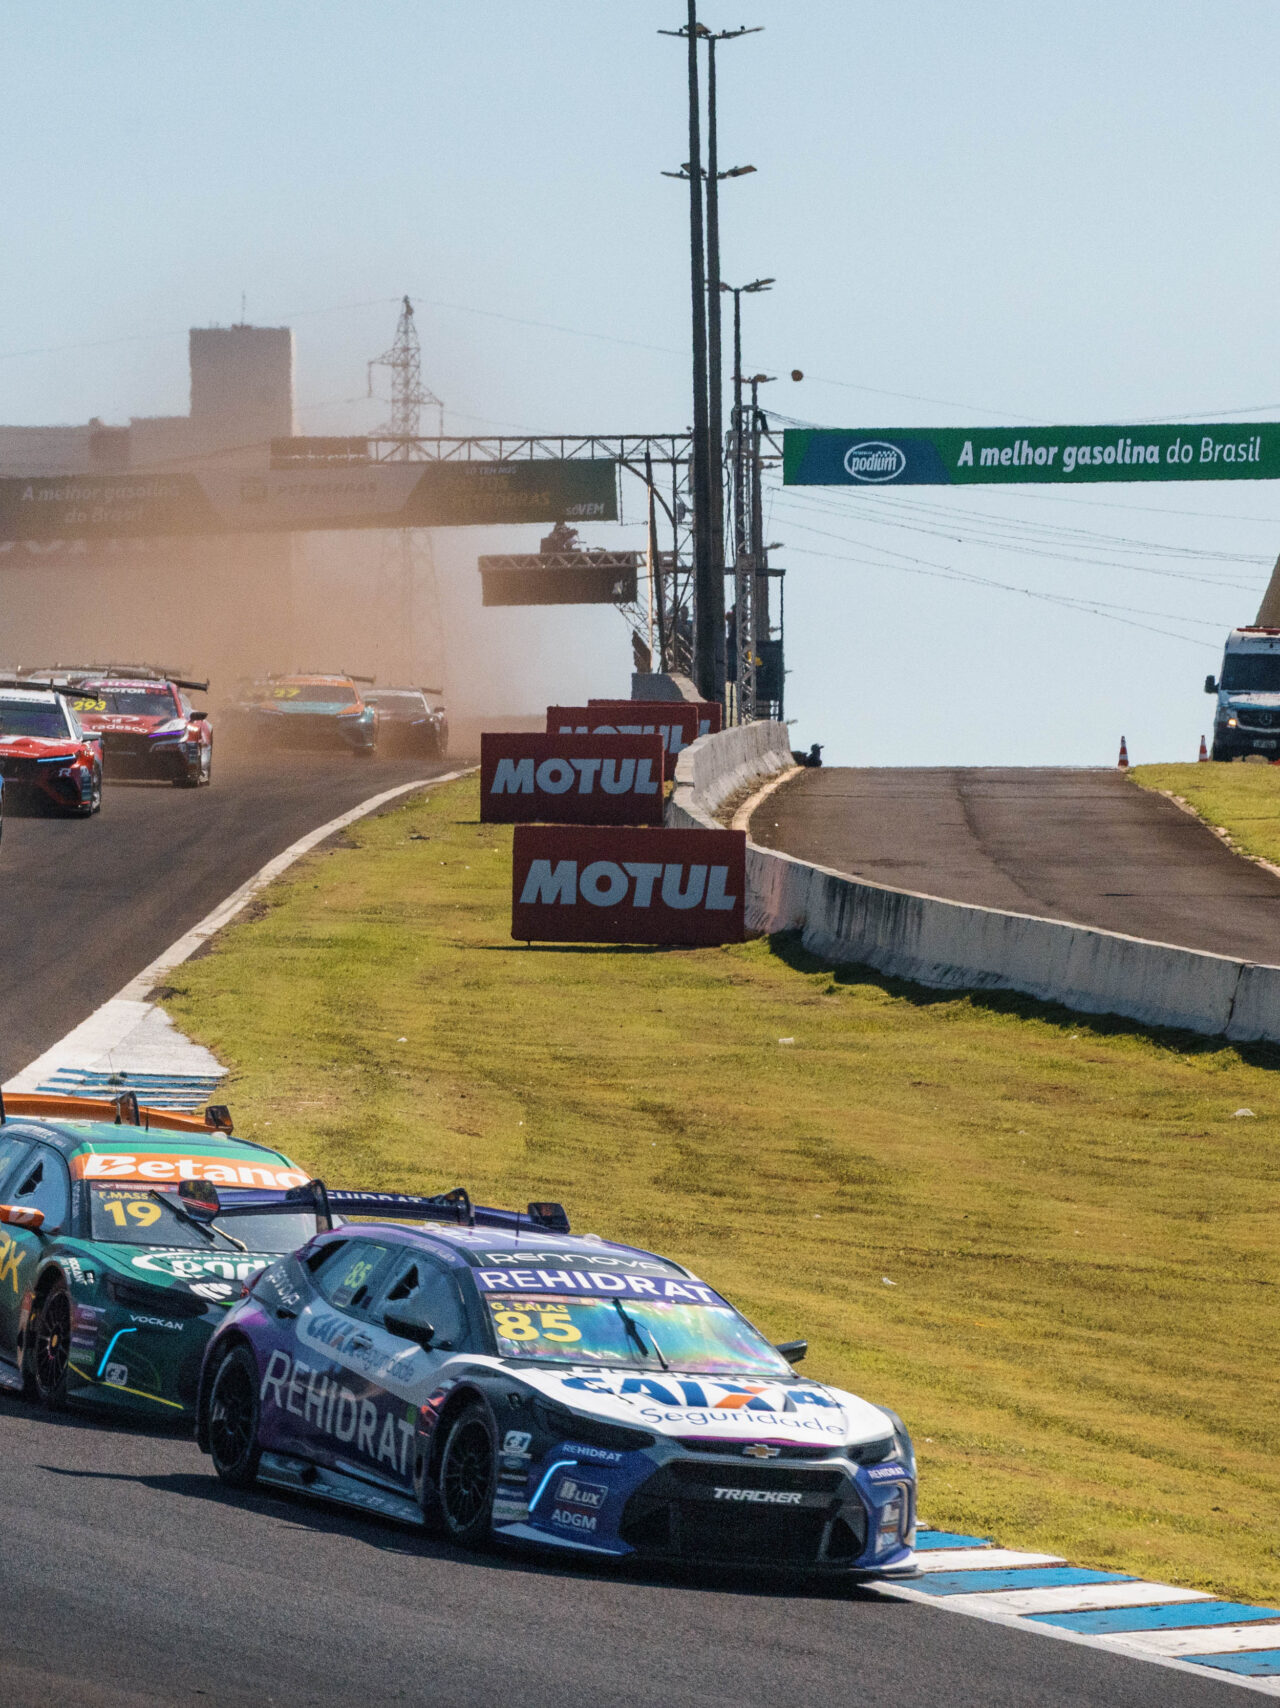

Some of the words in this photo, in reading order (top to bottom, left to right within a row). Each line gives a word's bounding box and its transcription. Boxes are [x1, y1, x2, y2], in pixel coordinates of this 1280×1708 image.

[851, 454, 897, 473] podium
[957, 441, 974, 466] A
[980, 440, 1058, 465] melhor
[1063, 438, 1160, 473] gasolina
[1166, 438, 1193, 464] do
[1199, 436, 1260, 463] Brasil
[274, 688, 301, 698] 27
[73, 700, 107, 712] 293
[490, 758, 659, 795] MOTUL
[519, 858, 737, 911] MOTUL
[84, 1154, 312, 1189] Betano
[98, 1191, 152, 1202] F.MASS
[104, 1200, 162, 1228] 19
[485, 1251, 668, 1273] RENNOVA
[343, 1261, 373, 1289] 85
[479, 1270, 714, 1303] REHIDRAT
[490, 1302, 509, 1312] G.
[513, 1303, 567, 1313] SALAS
[128, 1314, 185, 1331] VOCKAN
[494, 1311, 582, 1343] 85
[259, 1348, 417, 1477] REHIDRAT
[640, 1405, 846, 1435] Seguridade
[562, 1442, 622, 1462] REHIDRAT
[713, 1487, 802, 1504] TRACKER
[552, 1508, 597, 1530] ADGM
